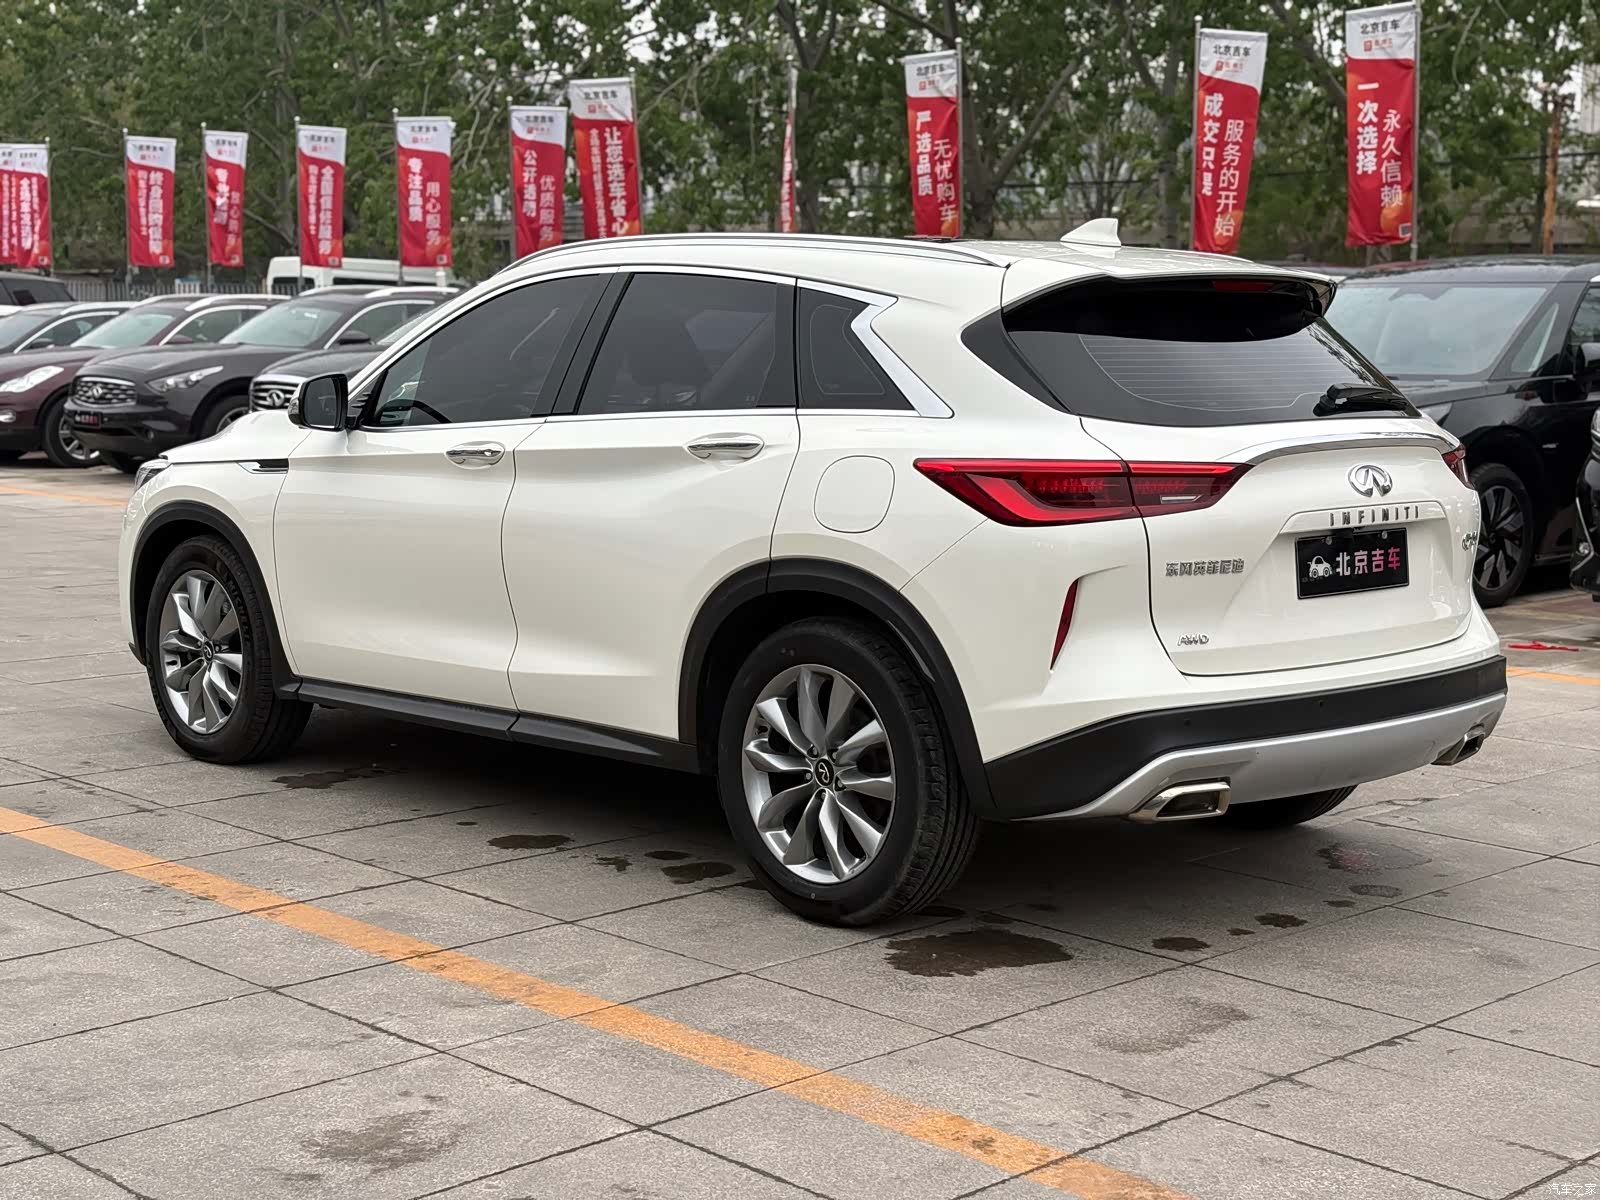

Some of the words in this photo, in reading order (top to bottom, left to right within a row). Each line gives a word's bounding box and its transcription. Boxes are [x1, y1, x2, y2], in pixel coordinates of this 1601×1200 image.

[916, 110, 933, 196] 严选品质
[1202, 93, 1224, 196] 成交只是
[1356, 82, 1379, 175] 一次选择
[1380, 109, 1403, 208] 永久信赖
[522, 150, 538, 217] 公开透明
[539, 175, 555, 241] 优质服务
[604, 126, 629, 235] 让您选车省心
[933, 139, 958, 222] 无忧购车
[1215, 119, 1244, 237] 服务的开始
[1330, 505, 1419, 527] INFINITI
[1165, 558, 1245, 577] 东风英菲尼迪
[1335, 546, 1401, 577] 北京吉车
[1177, 633, 1210, 647] AWD
